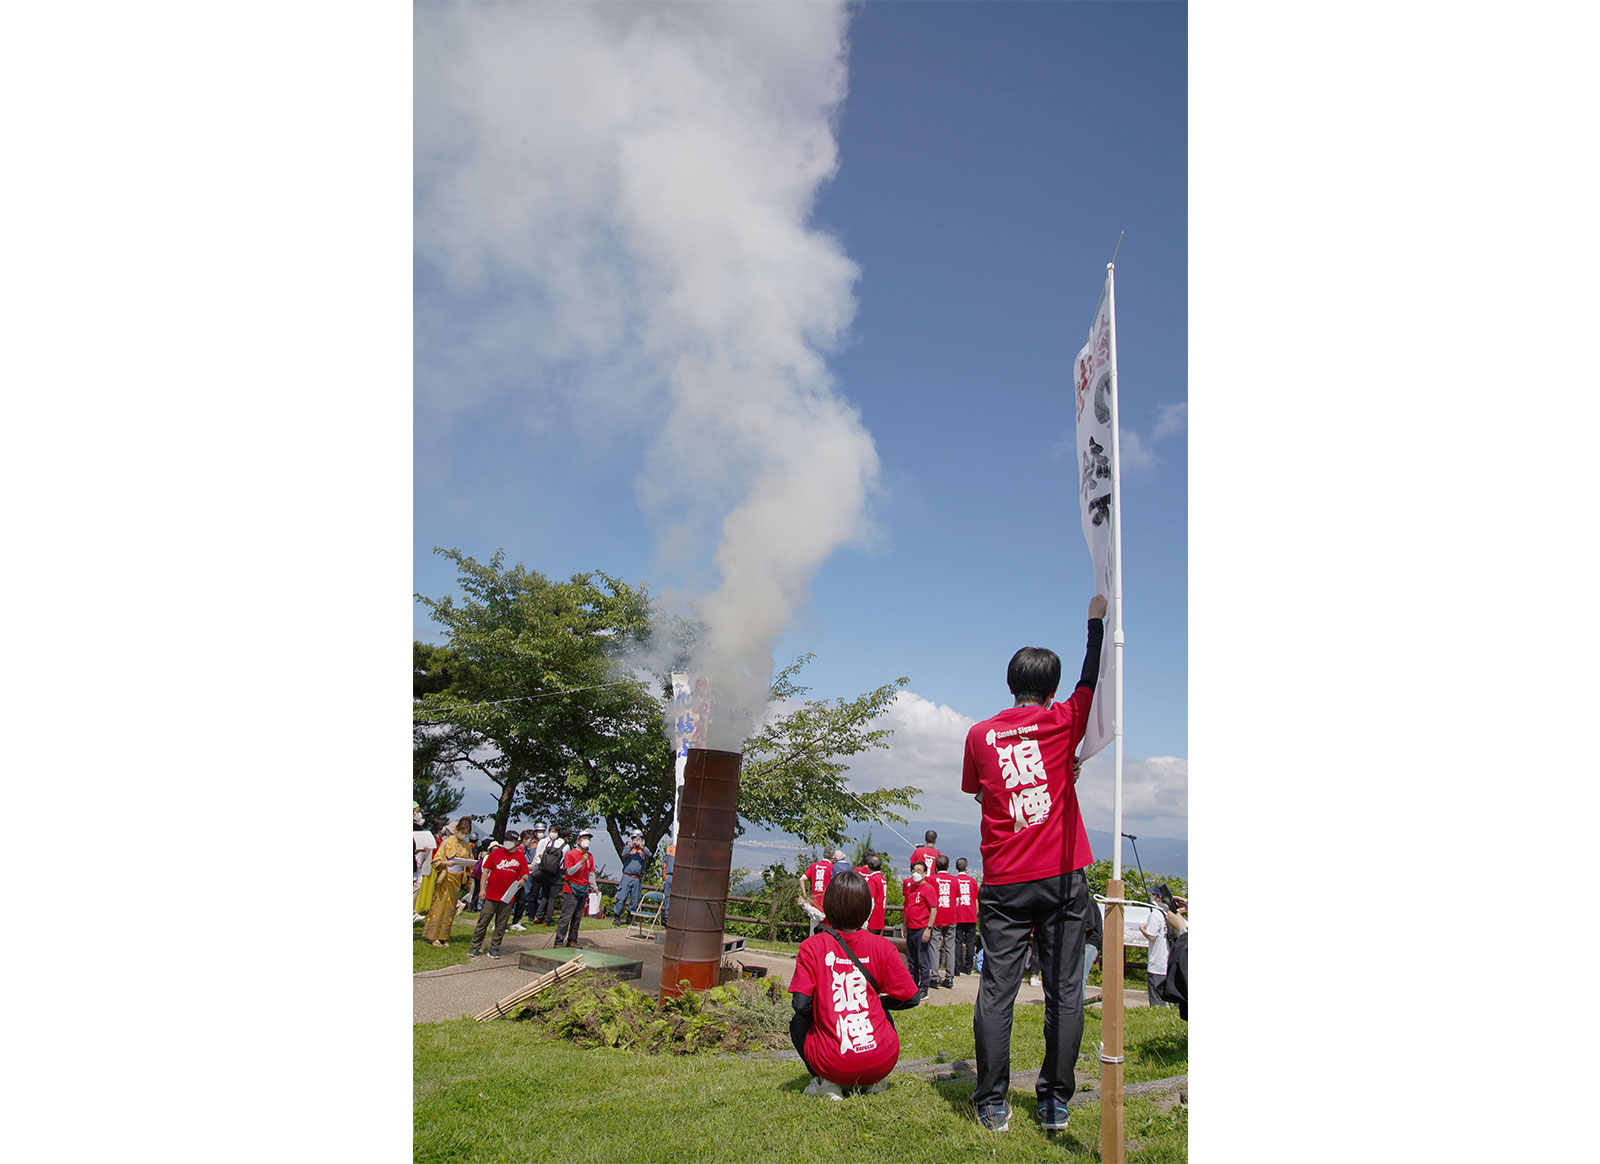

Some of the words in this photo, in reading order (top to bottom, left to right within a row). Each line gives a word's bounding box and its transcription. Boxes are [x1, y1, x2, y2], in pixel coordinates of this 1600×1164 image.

[996, 729, 1017, 739] Smoke
[1018, 723, 1038, 734] Signal
[995, 736, 1052, 833] 狼煙
[832, 965, 874, 1055] 狼煙
